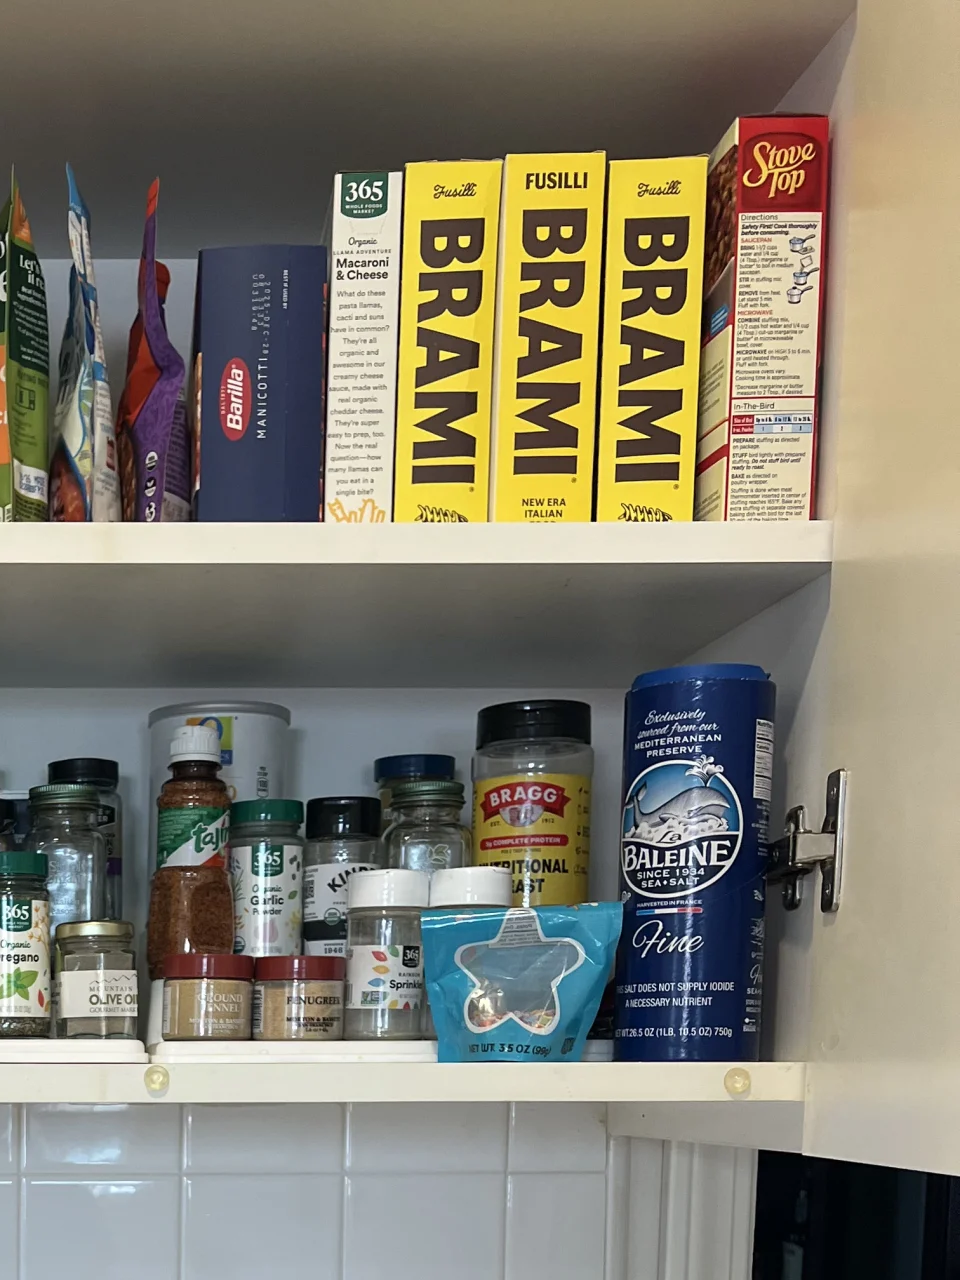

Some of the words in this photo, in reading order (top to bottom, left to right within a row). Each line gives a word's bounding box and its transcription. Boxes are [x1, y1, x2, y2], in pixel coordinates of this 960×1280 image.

[743, 142, 816, 187] Stove
[525, 172, 588, 189] FUSILLI
[763, 168, 805, 198] Top
[345, 179, 383, 202] 365
[433, 182, 477, 199] Fusilli
[637, 181, 681, 198] Fusilli
[349, 237, 377, 247] Organic
[336, 257, 389, 268] Macaroni
[336, 271, 344, 280] &
[347, 270, 388, 280] Cheese
[513, 208, 588, 475] BRAMI
[412, 217, 485, 484] BRAMI
[614, 215, 690, 483] BRAMI
[226, 369, 243, 430] Barilla
[257, 358, 268, 438] MANICOTTI
[352, 396, 378, 404] organic
[734, 402, 774, 410] In-The-Bird
[522, 498, 545, 506] NEW
[547, 498, 566, 506] ERA
[525, 510, 562, 518] ITALIAN
[644, 708, 706, 725] Exclusively
[637, 725, 670, 739] sourced
[668, 722, 697, 737] from
[700, 723, 720, 731] our
[634, 734, 722, 750] MEDITERRANEAN
[646, 745, 702, 758] PRESERVE
[490, 786, 557, 807] BRAGG
[493, 838, 528, 846] COMPLETE
[656, 831, 682, 843] La
[254, 850, 280, 866] 365
[624, 840, 732, 872] BALEINE
[479, 859, 568, 873] RITIONAL
[327, 867, 376, 893] KIN
[637, 869, 670, 880] SINCE
[676, 868, 705, 876] 1934
[252, 884, 282, 895] Oganic
[512, 878, 545, 893] EAST
[250, 895, 284, 906] Garlic
[4, 904, 29, 920] 365
[0, 939, 31, 951] Organic
[632, 920, 704, 958] Fine
[404, 949, 418, 960] 365
[624, 984, 637, 993] SALT
[638, 983, 656, 992] DOES
[659, 982, 675, 992] NOT
[677, 982, 708, 991] SUPPLY
[710, 982, 734, 991] IODIDE
[89, 994, 122, 1005] OLIVE
[197, 994, 242, 1002] GROUND
[625, 999, 630, 1008] A
[630, 998, 670, 1007] NECESSARY
[672, 997, 713, 1006] NUTRIENT
[207, 1003, 239, 1012] ENNEL
[644, 1028, 654, 1037] OZ
[656, 1027, 676, 1038] (1LB,
[679, 1028, 696, 1037] 10.5
[699, 1027, 712, 1036] OZ)
[714, 1027, 732, 1038] 750g
[499, 1044, 513, 1053] 3.5
[516, 1044, 530, 1054] OZ
